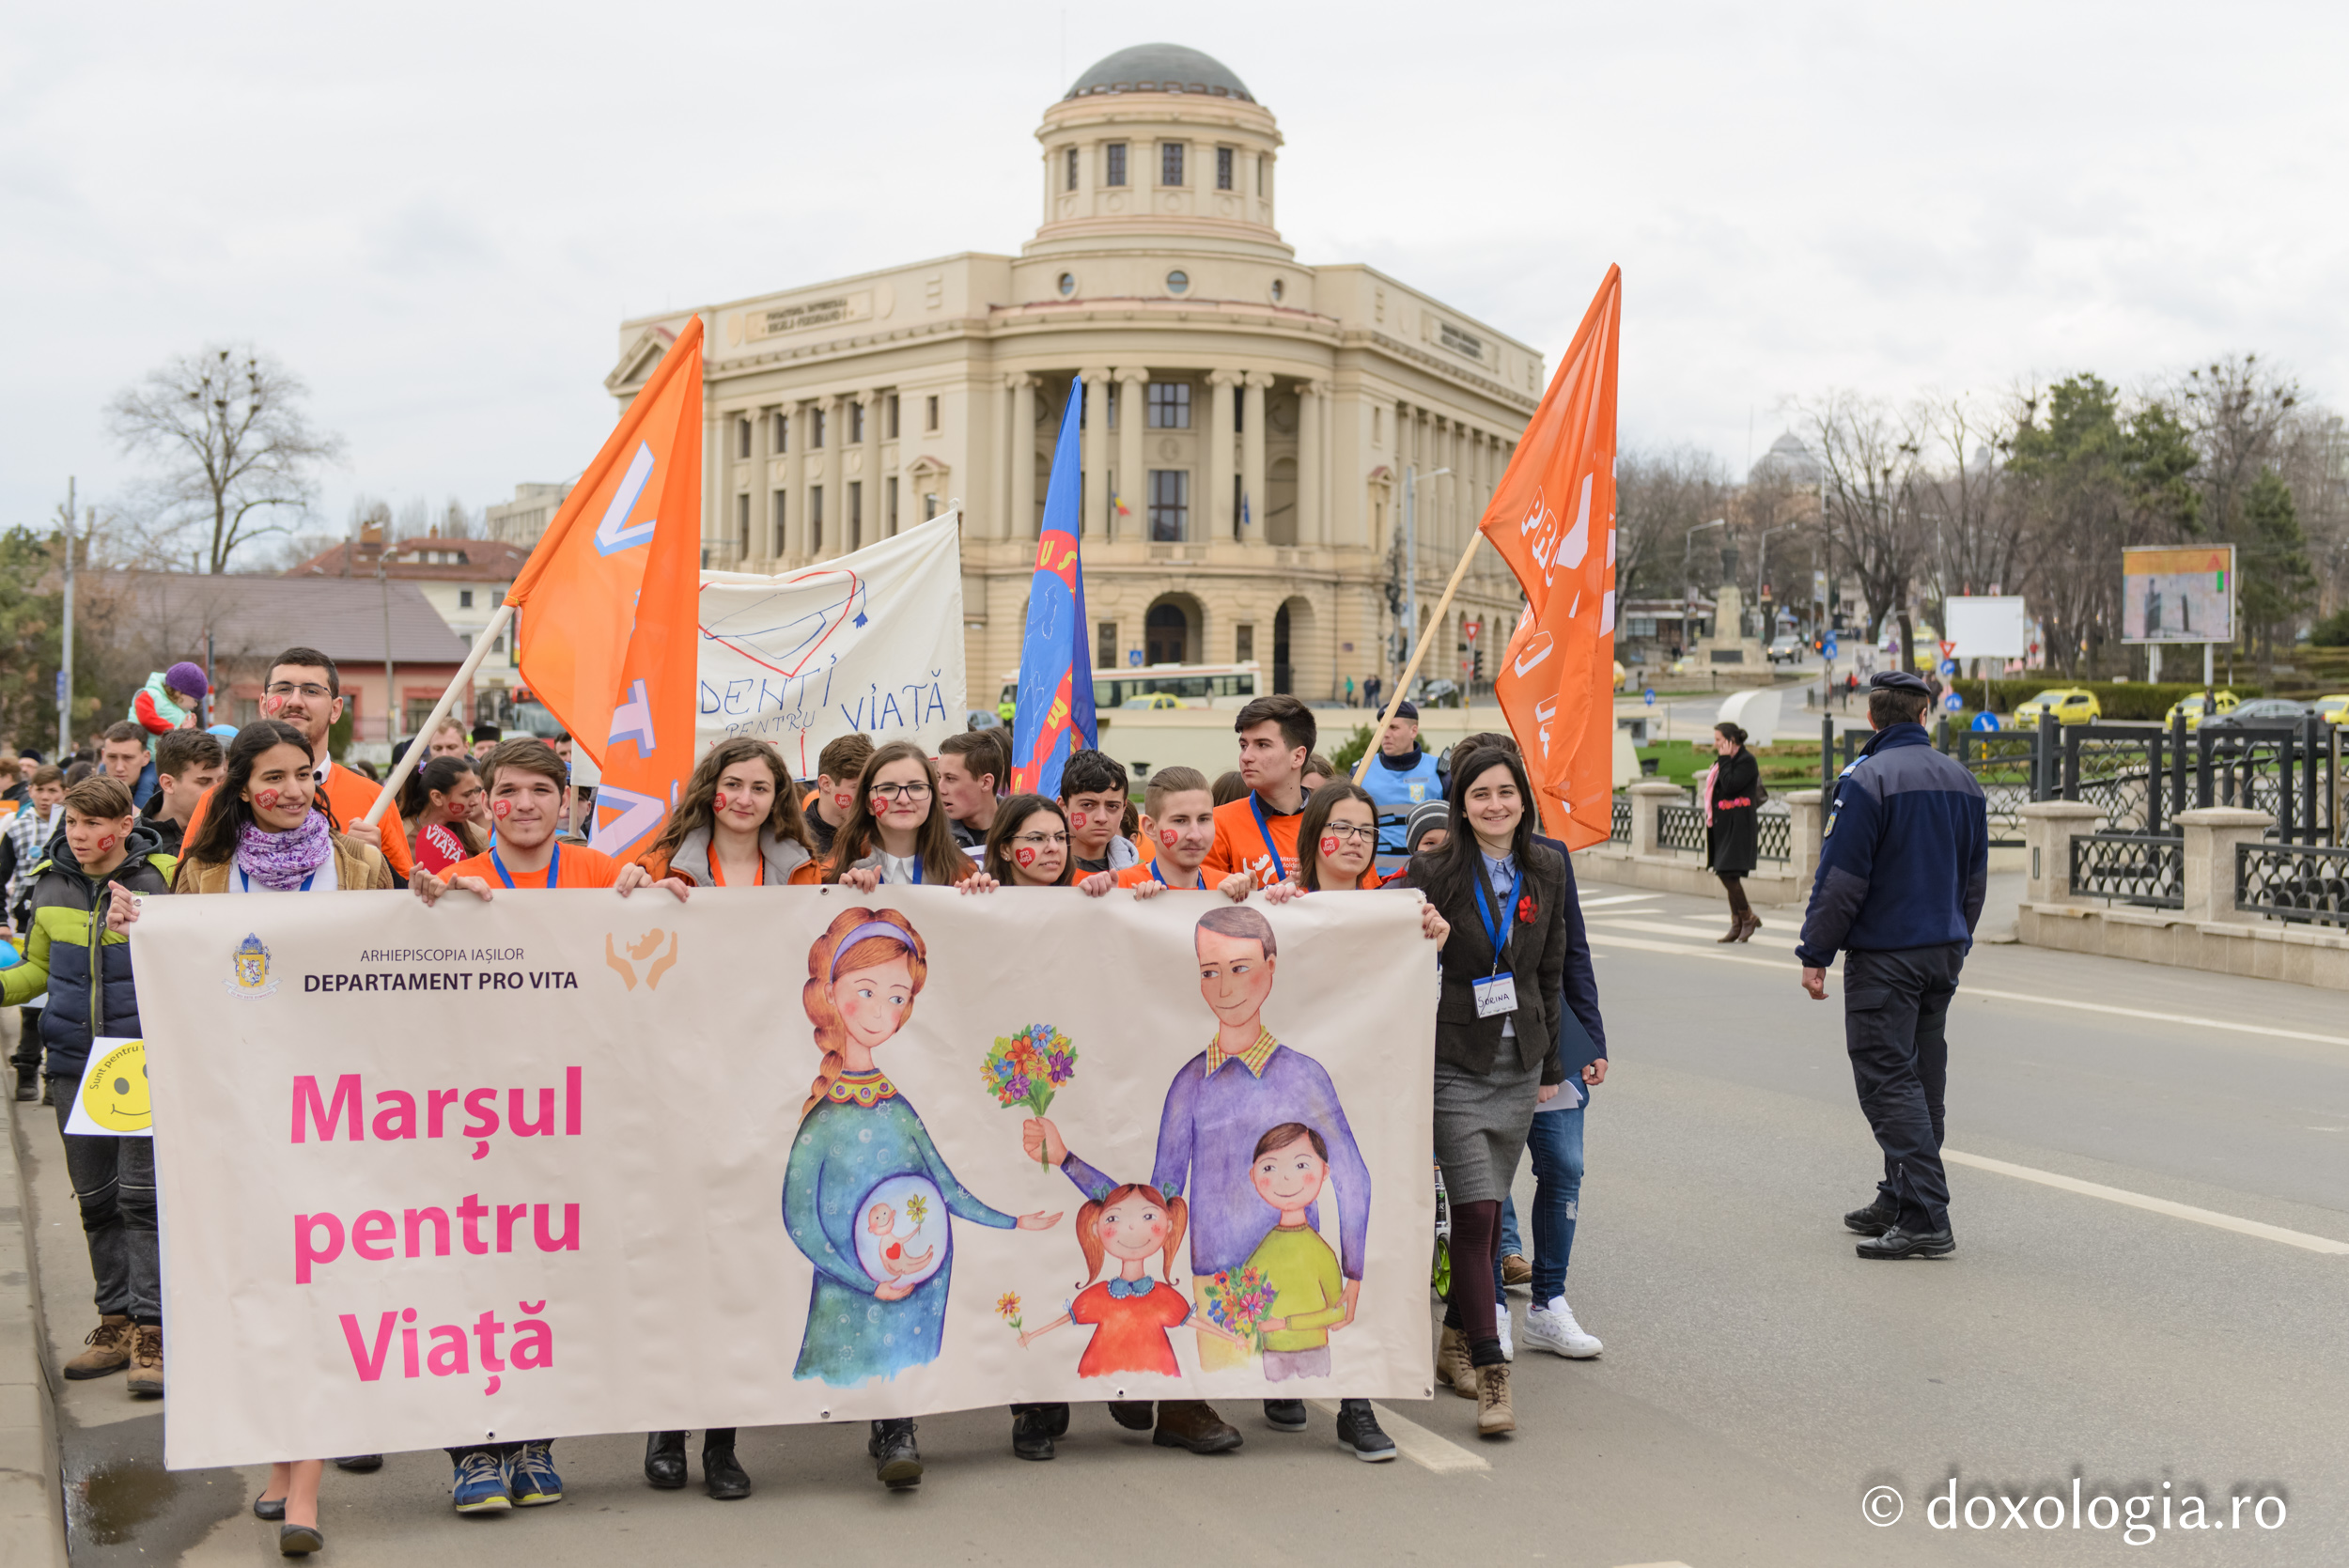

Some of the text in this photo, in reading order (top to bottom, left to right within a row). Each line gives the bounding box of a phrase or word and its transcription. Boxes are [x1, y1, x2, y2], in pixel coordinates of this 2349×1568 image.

[360, 948, 524, 964] ARHIEPISCOPIA IAȘILOR
[303, 971, 579, 993] DEPARTAMENT PRO VITA
[1478, 993, 1510, 1008] SORINA
[89, 1046, 139, 1090] Sunt pentru
[291, 1066, 582, 1160] Marșul
[293, 1193, 580, 1284] pentru
[339, 1300, 553, 1396] Viață
